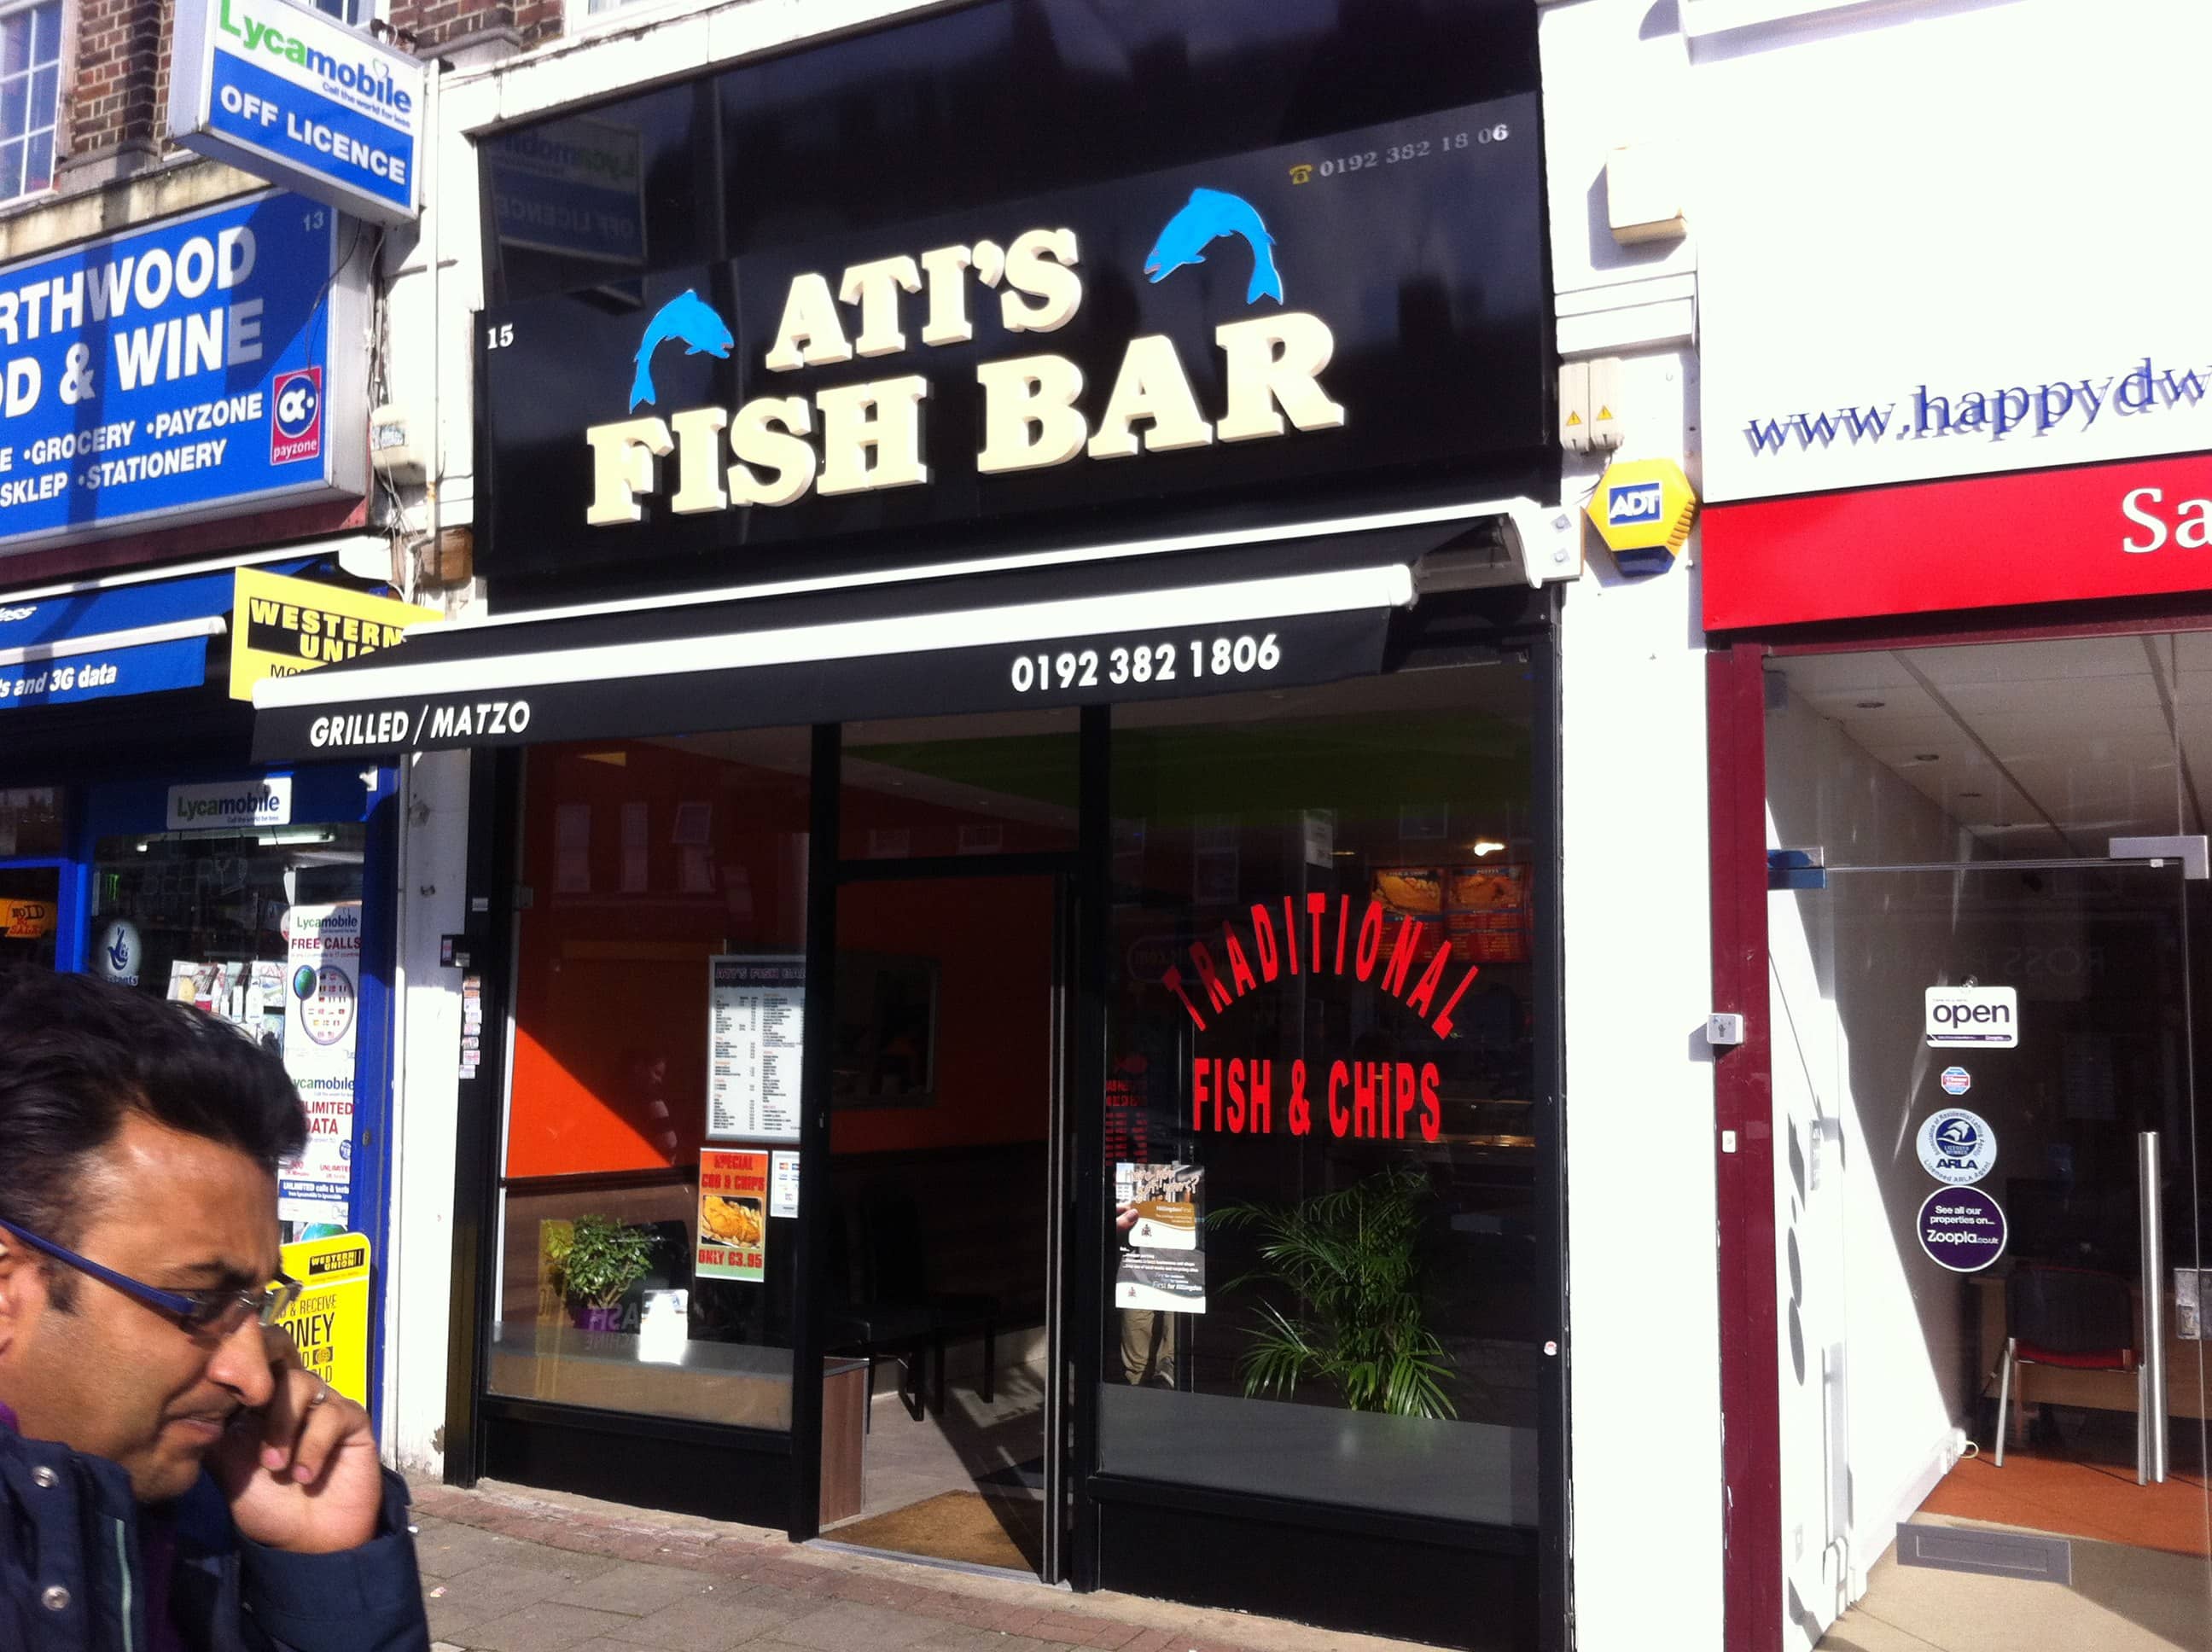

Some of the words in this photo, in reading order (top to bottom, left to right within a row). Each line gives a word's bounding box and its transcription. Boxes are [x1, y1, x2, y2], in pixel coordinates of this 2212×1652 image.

[219, 0, 411, 114] Lycamobile
[220, 84, 279, 127] OFF
[287, 112, 406, 186] LICENCE
[1319, 151, 1378, 177] 0192
[1385, 139, 1431, 165] 382
[1442, 132, 1469, 153] 18
[1477, 124, 1509, 145] 06
[303, 211, 324, 231] 13
[766, 229, 1081, 371] ATI'S
[486, 323, 514, 349] 15
[59, 342, 96, 405] &
[114, 298, 265, 393] WINE
[587, 375, 929, 526] FISH
[976, 311, 1345, 474] BAR
[273, 438, 317, 462] payzone
[1610, 491, 1661, 521] ADT
[250, 598, 405, 649] WESTERN
[300, 633, 375, 663] UNI
[1010, 649, 1099, 693] 0192
[1109, 643, 1177, 684] 382
[1190, 632, 1280, 677] 1806
[14, 672, 48, 696] and
[49, 666, 75, 692] 3G
[78, 663, 118, 689] data
[310, 711, 410, 747] GRILLED
[430, 701, 531, 740] MATZO
[177, 784, 280, 821] Lycamobile
[296, 915, 358, 930] Lycamobile
[291, 938, 321, 950] FREE
[324, 937, 361, 950] CALLS
[1161, 892, 1478, 1040] TRADITIONAL
[1933, 1004, 2011, 1029] open
[294, 1077, 354, 1091] ycamobile
[1194, 1057, 1271, 1134] FISH
[1288, 1058, 1312, 1137] &
[1328, 1060, 1441, 1142] CHIPS
[1936, 1158, 1978, 1170] ARLA
[735, 1176, 765, 1192] CHIPS
[1930, 1216, 1975, 1225] properties
[1935, 1205, 1953, 1214] See
[1954, 1206, 1965, 1215] all
[311, 1253, 355, 1266] WESTERN
[323, 1259, 355, 1271] UNION
[698, 1249, 725, 1265] ONLY
[300, 1294, 337, 1315] RECEIVE
